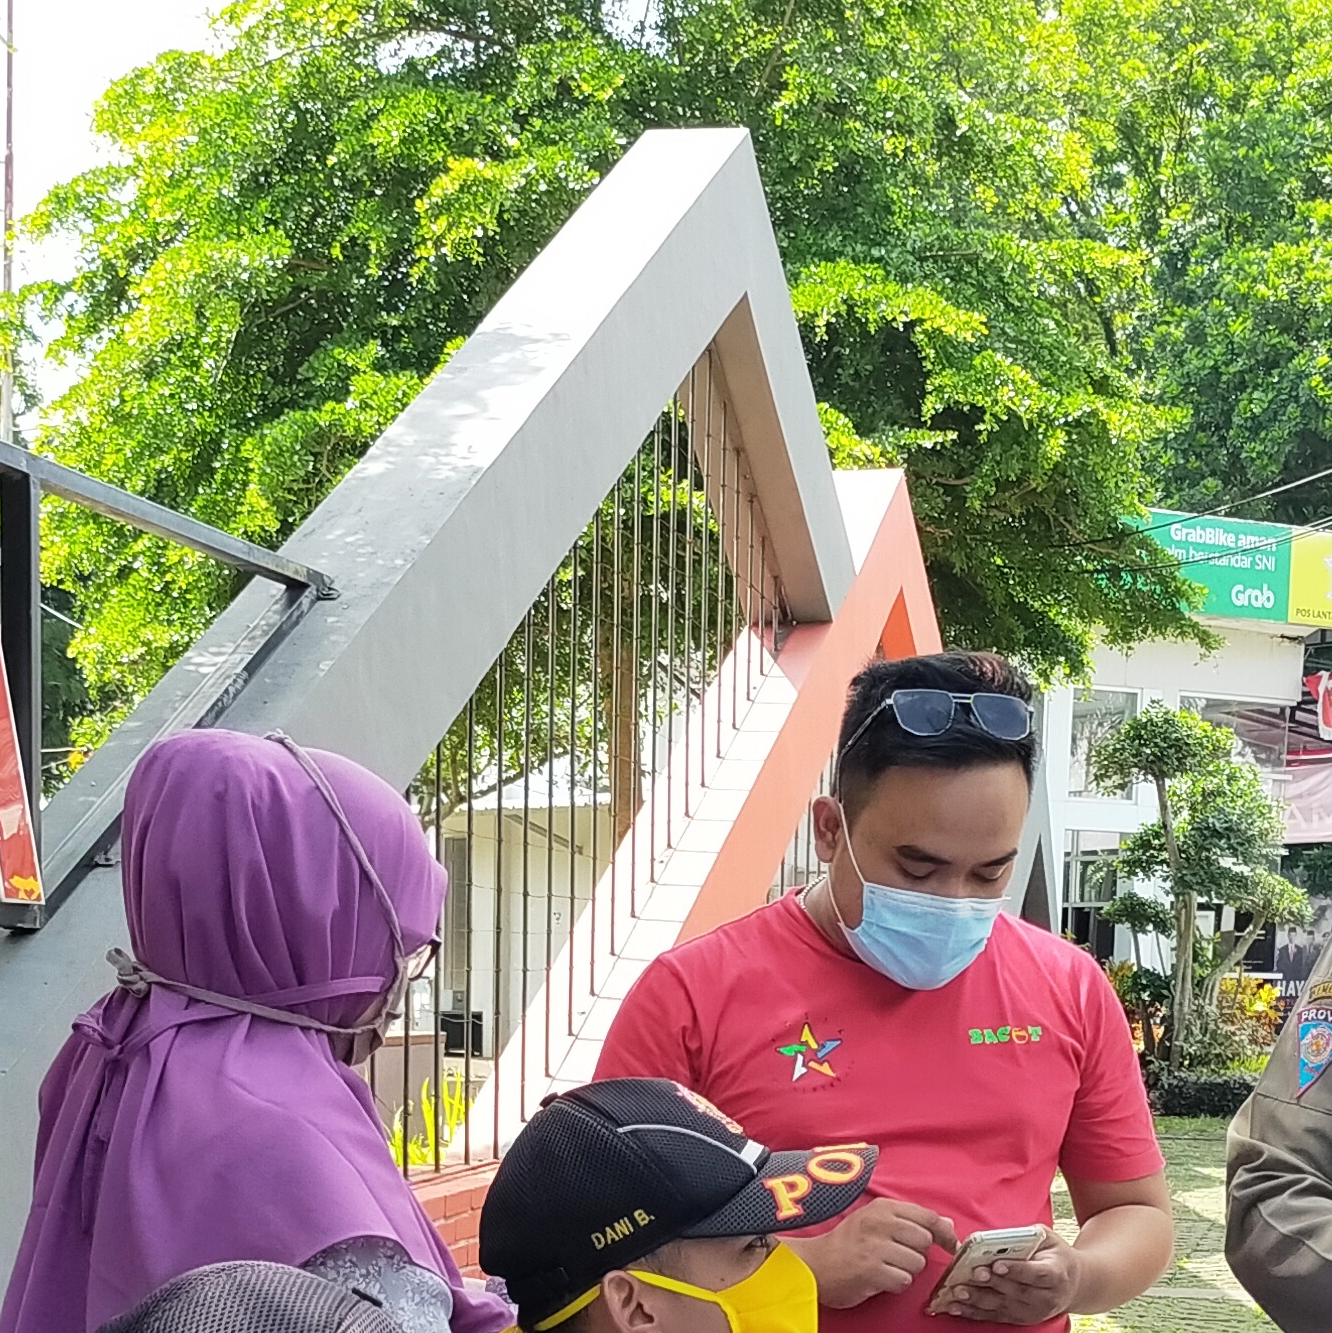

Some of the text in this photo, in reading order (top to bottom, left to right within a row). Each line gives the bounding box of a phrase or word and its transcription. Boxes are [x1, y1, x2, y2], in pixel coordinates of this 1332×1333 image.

[1170, 523, 1277, 552] GrabBike aman
[1254, 554, 1276, 572] SNI
[1231, 583, 1275, 608] Grab
[1295, 607, 1311, 619] POS
[762, 1142, 868, 1221] PO
[591, 1217, 633, 1250] DANI
